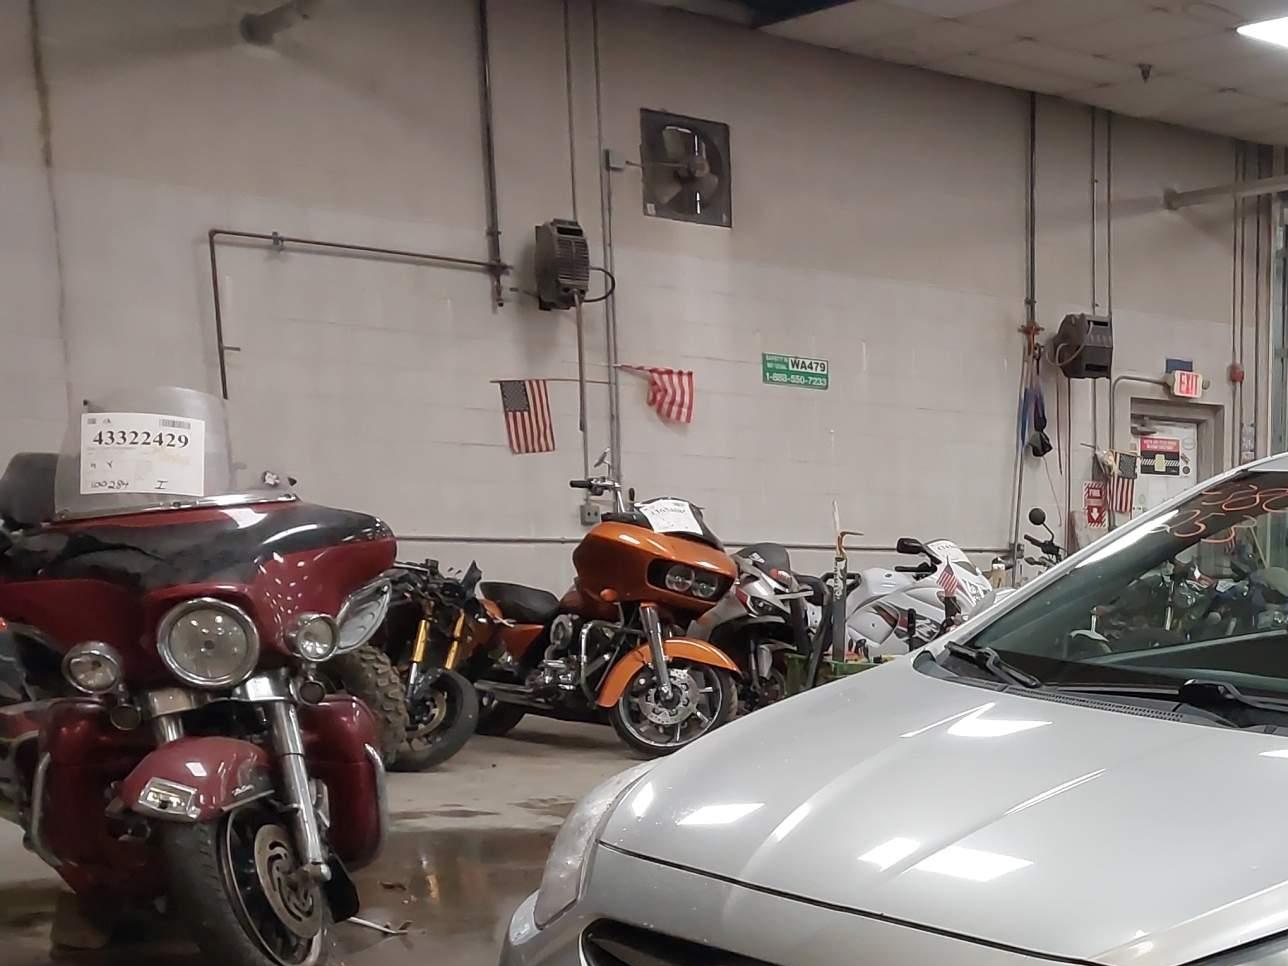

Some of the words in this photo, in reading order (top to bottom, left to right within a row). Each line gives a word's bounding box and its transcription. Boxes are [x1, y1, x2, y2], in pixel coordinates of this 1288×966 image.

[790, 359, 825, 372] WA479
[1180, 372, 1199, 395] EXIT
[93, 430, 189, 448] 43322429
